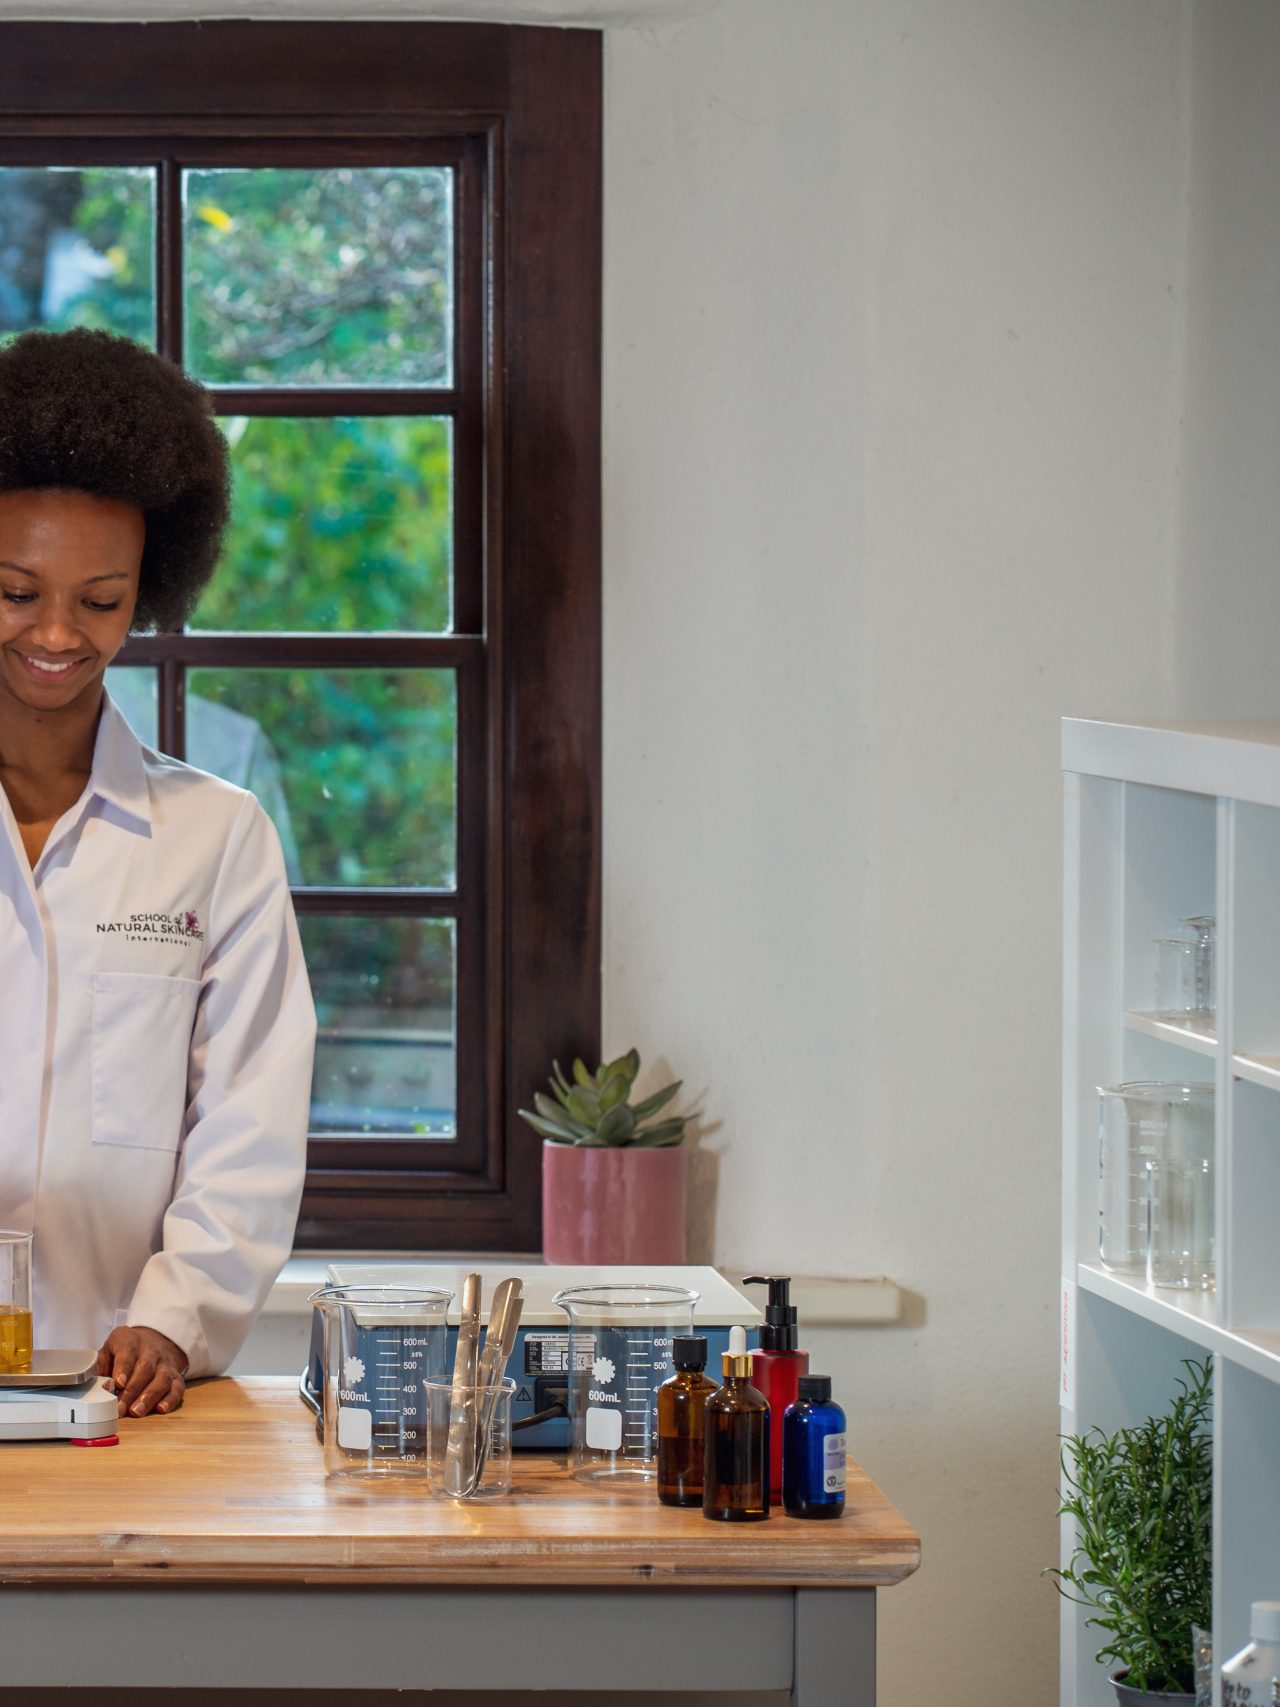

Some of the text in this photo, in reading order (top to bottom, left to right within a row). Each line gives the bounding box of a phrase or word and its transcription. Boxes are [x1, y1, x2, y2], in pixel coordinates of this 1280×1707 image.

[130, 912, 183, 925] SCHOOL of
[96, 923, 204, 941] NATURAL SKINCARE
[126, 934, 191, 947] International
[403, 1361, 417, 1370] 500
[653, 1361, 667, 1370] 500
[402, 1385, 417, 1393] 400
[340, 1390, 371, 1402] 600mL
[588, 1390, 621, 1403] 600mL
[402, 1407, 417, 1416] 300
[402, 1431, 416, 1439] 200
[403, 1454, 416, 1462] 100
